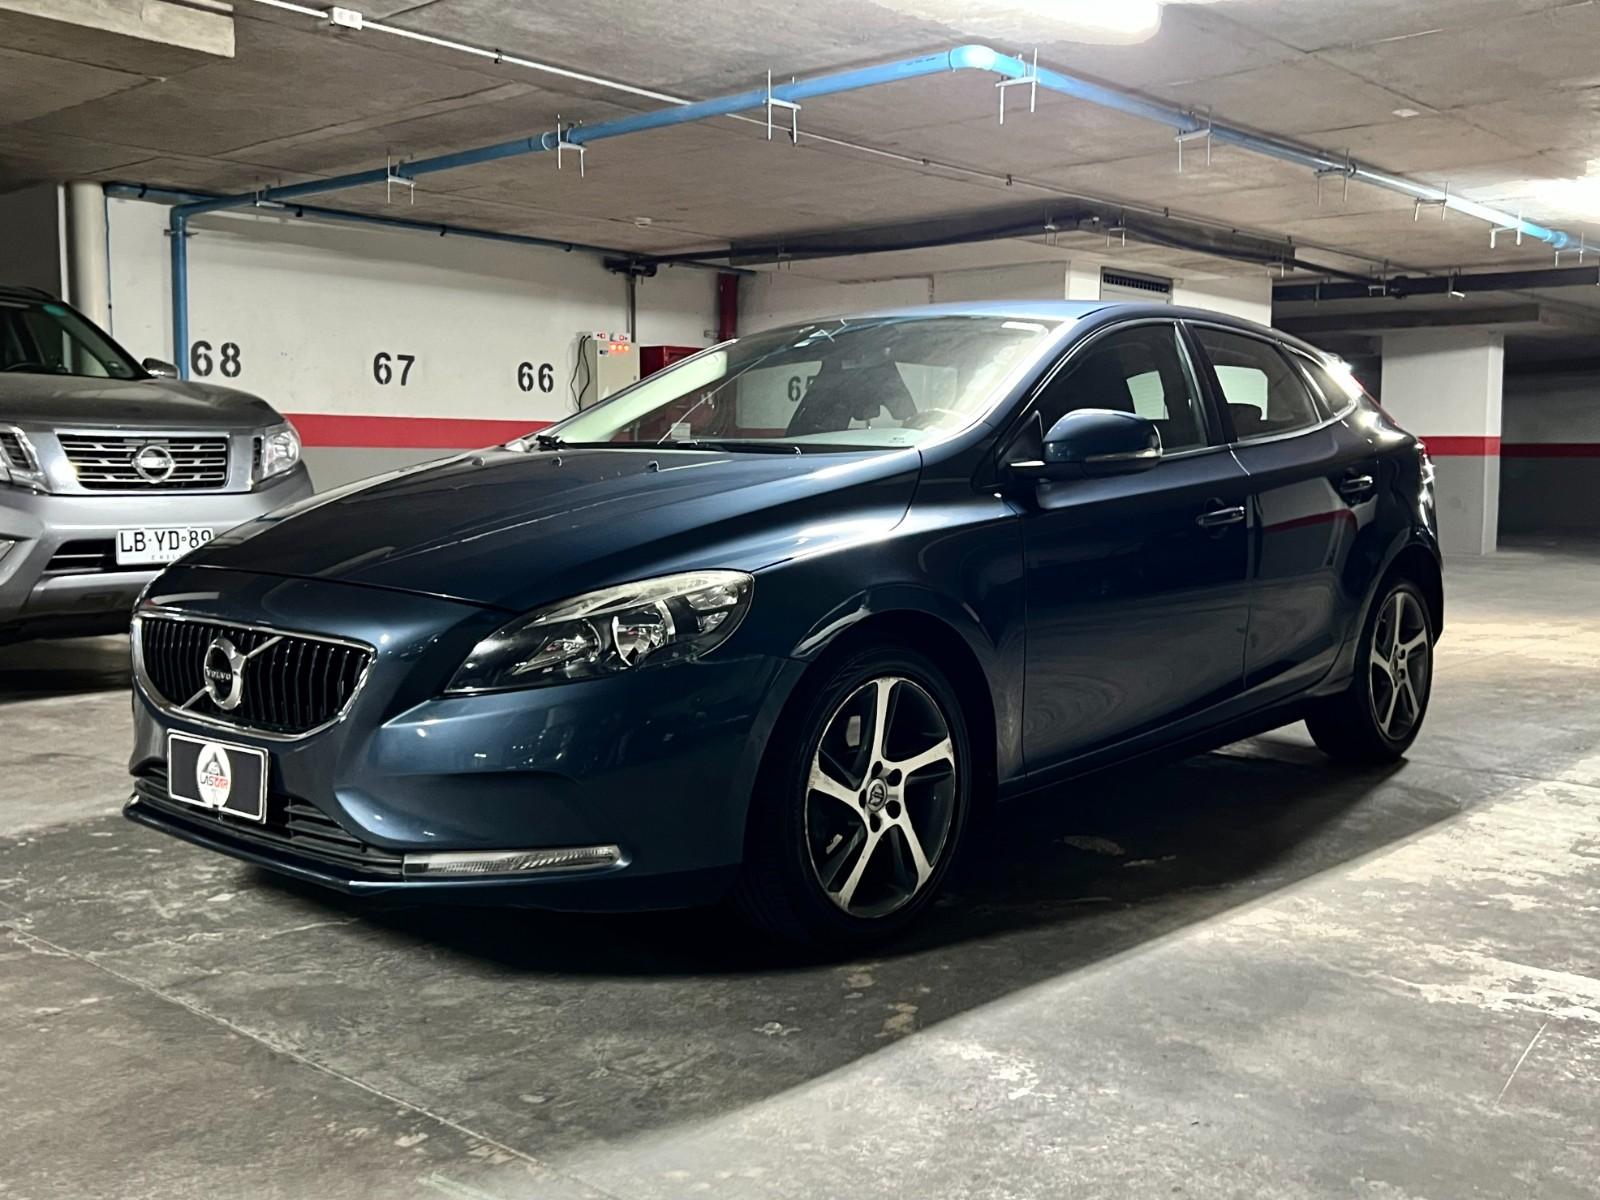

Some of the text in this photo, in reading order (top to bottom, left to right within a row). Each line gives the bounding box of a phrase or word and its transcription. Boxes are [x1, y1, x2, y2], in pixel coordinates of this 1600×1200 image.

[190, 340, 242, 378] 68
[373, 352, 416, 386] 67
[517, 362, 554, 393] 66
[206, 669, 232, 681] VOLVO
